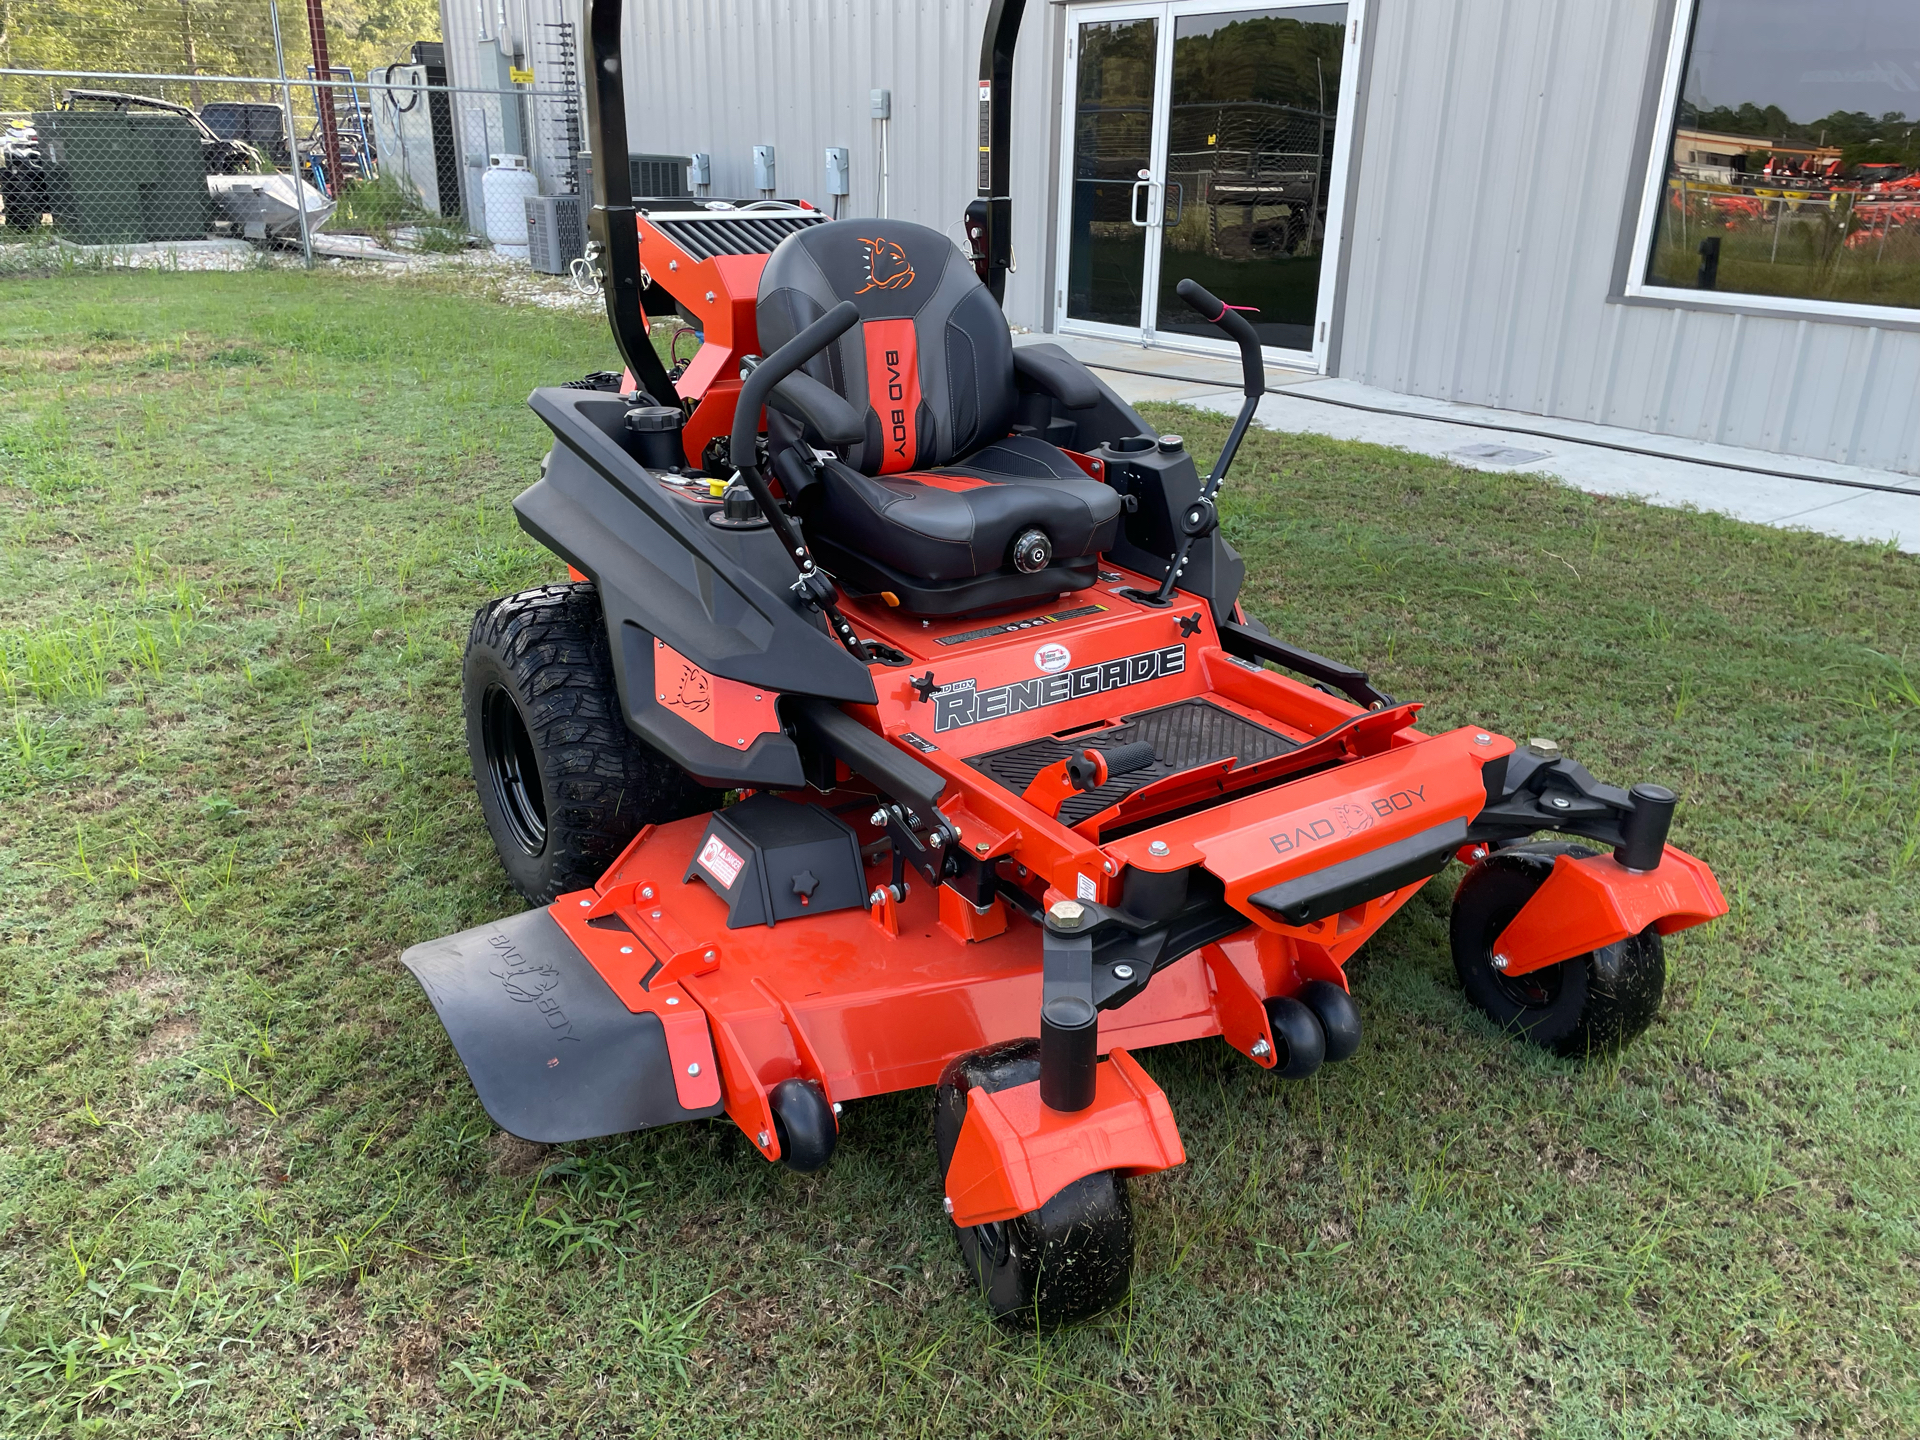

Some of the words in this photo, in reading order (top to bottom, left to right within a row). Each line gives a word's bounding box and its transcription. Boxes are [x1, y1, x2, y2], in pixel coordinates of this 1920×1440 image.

[885, 350, 903, 401] BAD
[891, 409, 907, 458] BOY
[933, 644, 1185, 732] RENEGADE
[953, 679, 975, 691] BOY
[1269, 819, 1335, 854] BAD
[1371, 784, 1426, 817] BOY
[487, 935, 526, 967] BAD
[535, 998, 581, 1041] BOY
